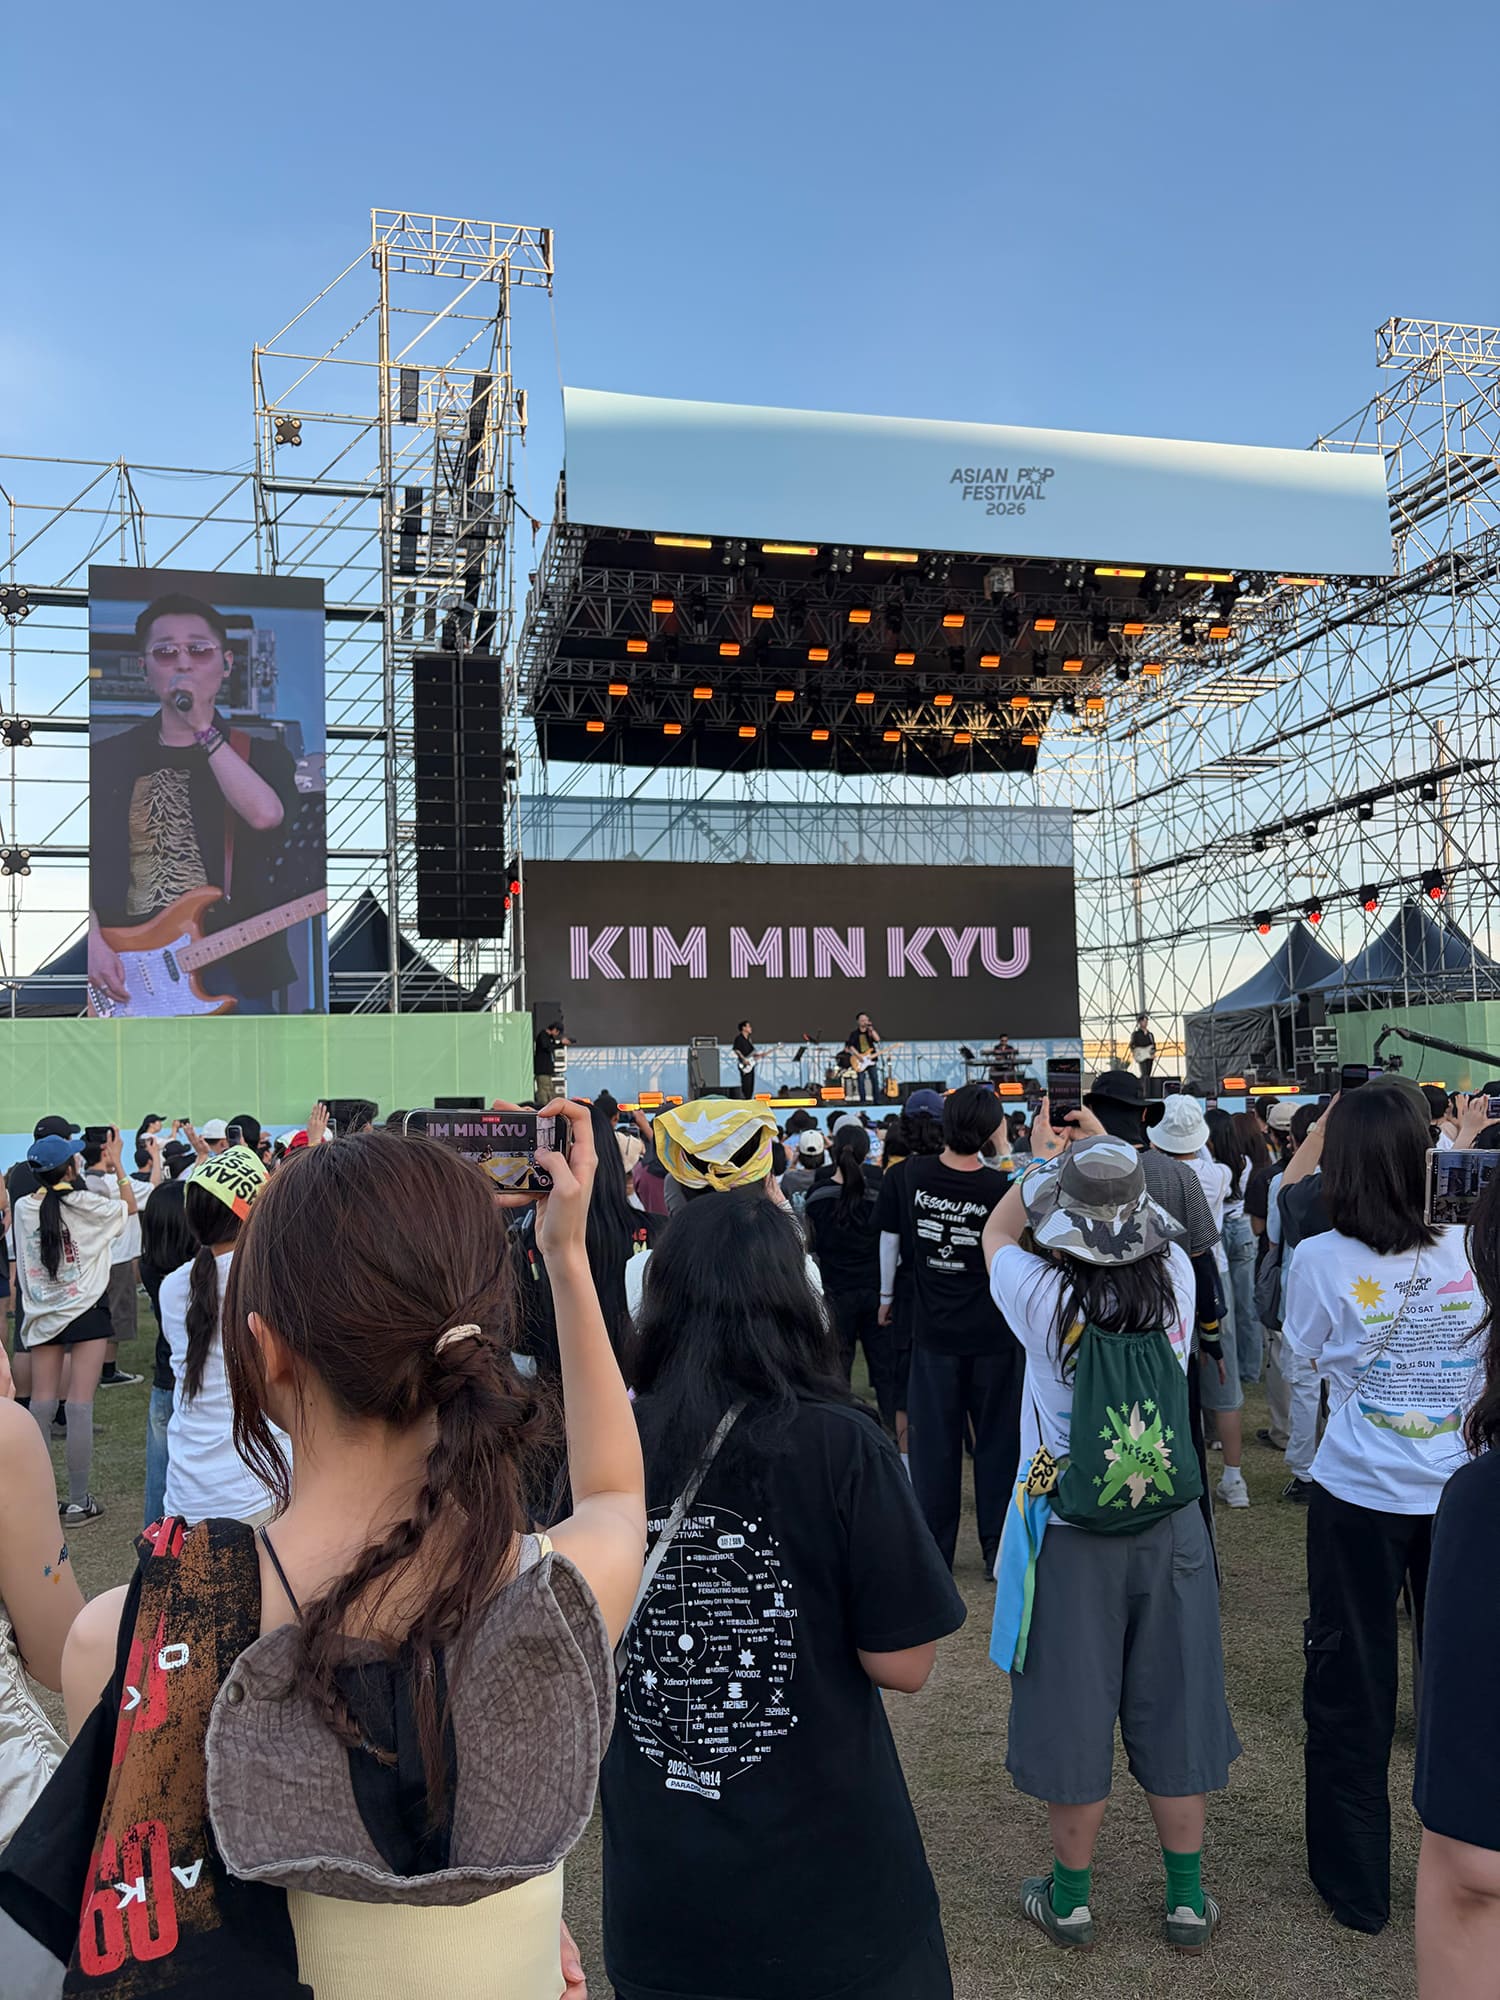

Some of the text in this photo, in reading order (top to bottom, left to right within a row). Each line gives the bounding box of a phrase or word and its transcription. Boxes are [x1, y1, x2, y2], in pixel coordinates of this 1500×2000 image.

[950, 466, 1055, 486] ASIAN POP
[962, 485, 1046, 501] FESTIVAL
[985, 502, 1026, 516] 2026
[569, 925, 1032, 980] KIM MIN KYU
[454, 1123, 488, 1137] MIN
[492, 1123, 527, 1137] KYU
[960, 1201, 988, 1217] BAND
[1399, 1283, 1428, 1294] FEIVAL
[1418, 1305, 1434, 1313] SAT
[1417, 1360, 1435, 1368] SUN
[673, 1530, 704, 1539] STIVAL
[735, 1670, 761, 1678] WOODZ
[664, 1677, 713, 1687] Xdinary Heroes
